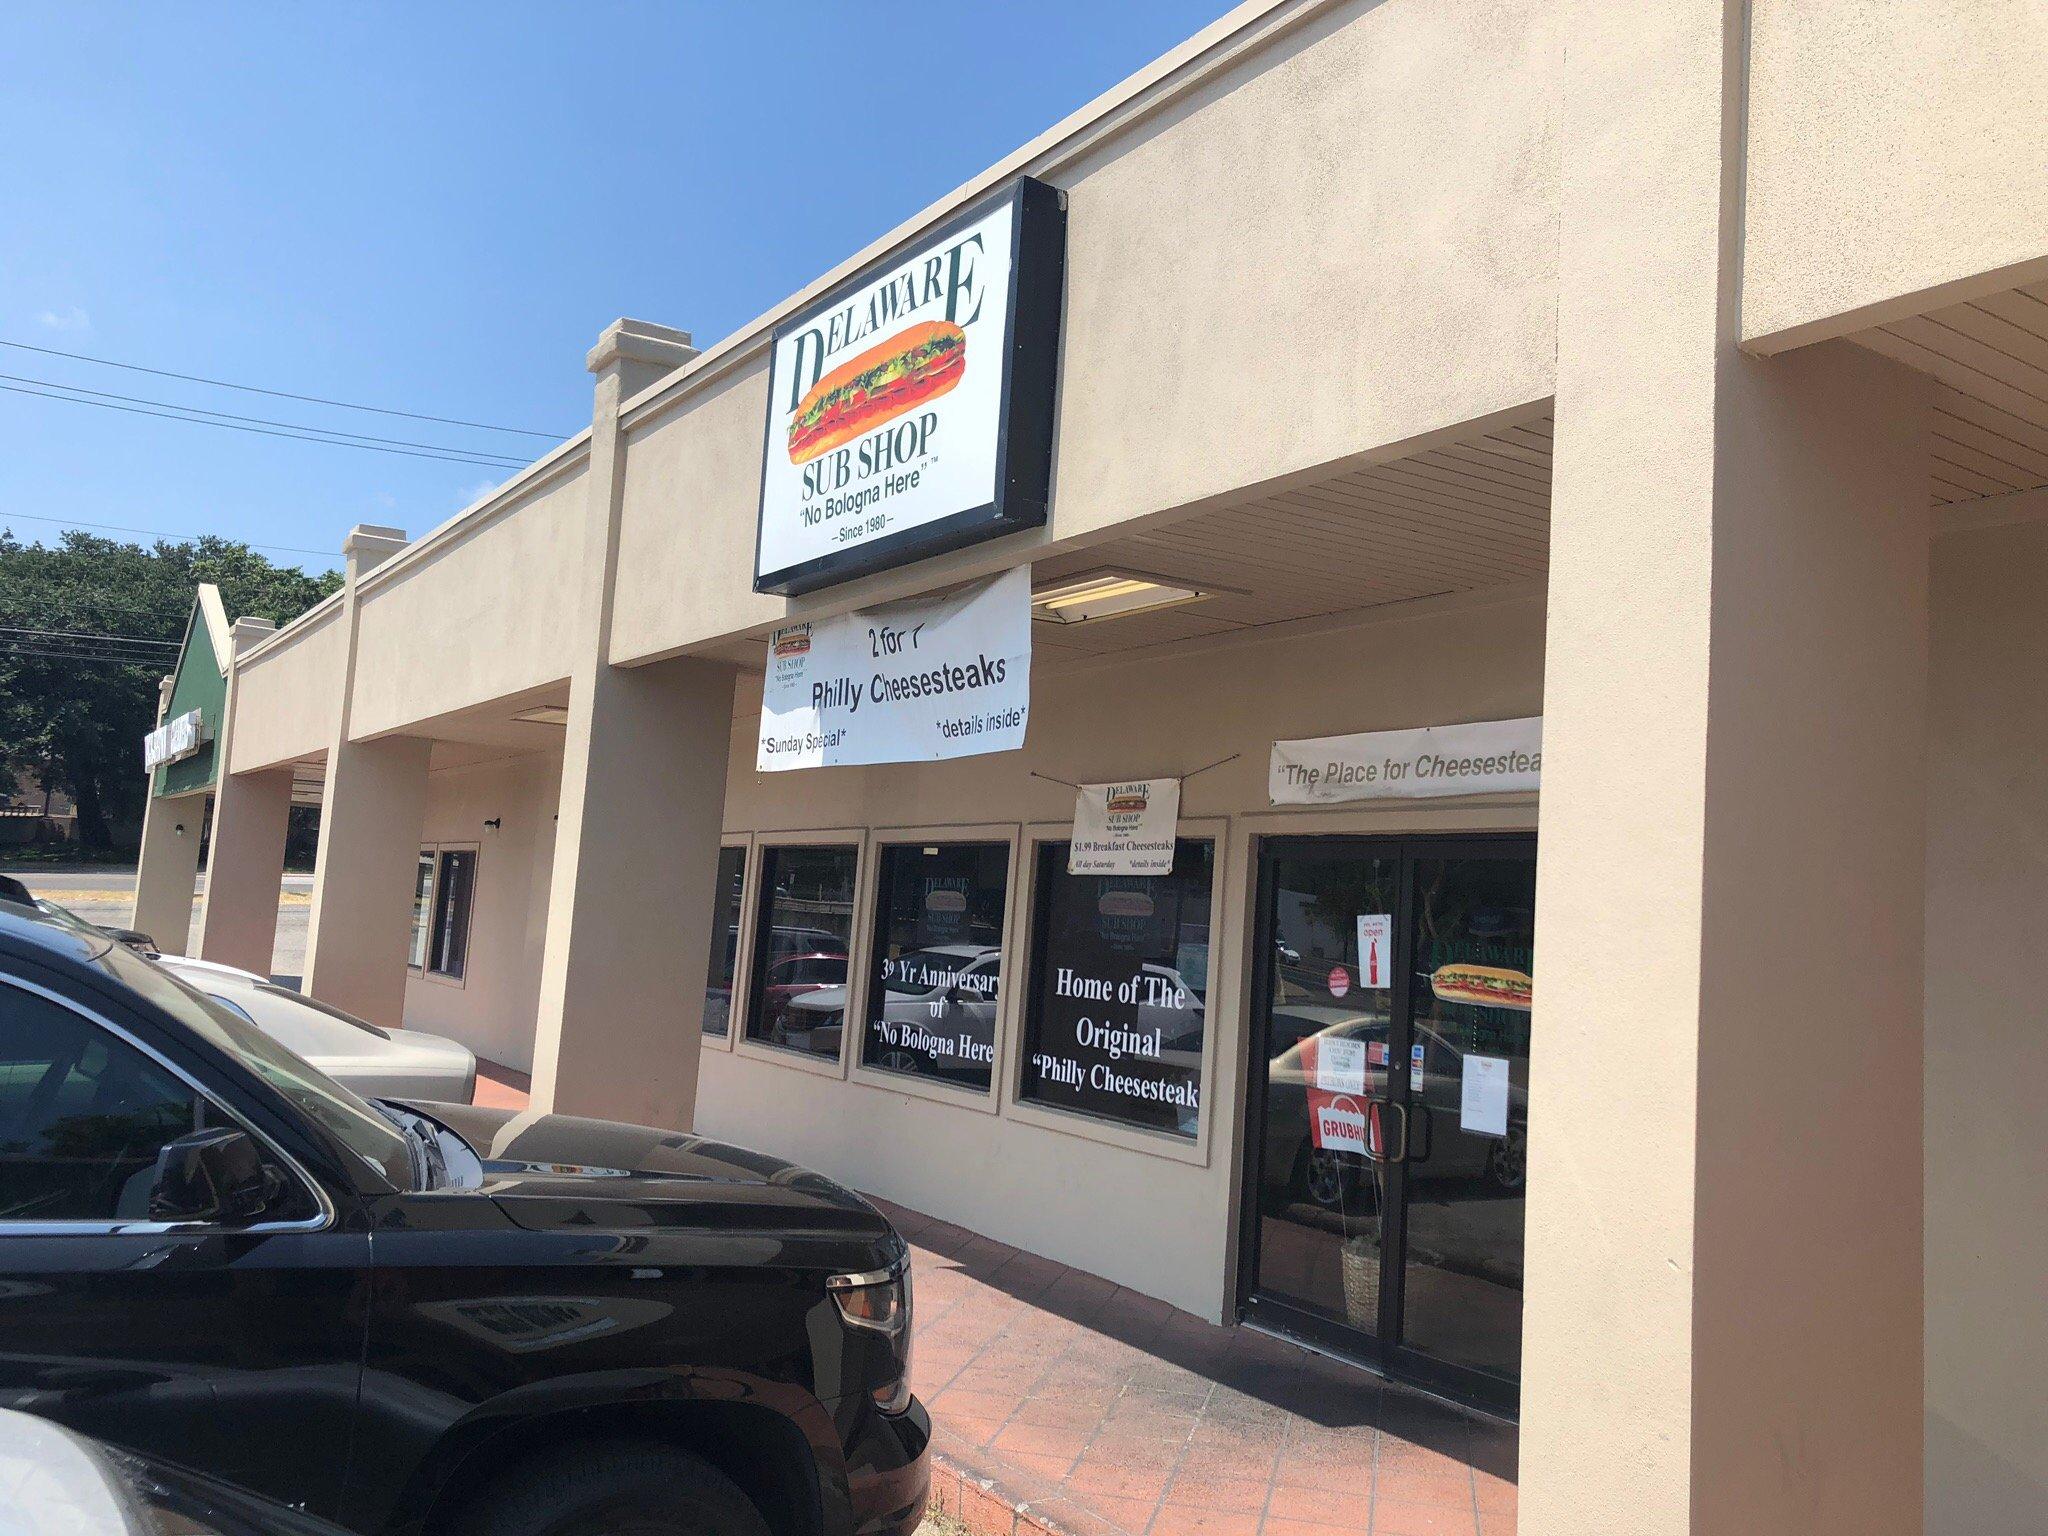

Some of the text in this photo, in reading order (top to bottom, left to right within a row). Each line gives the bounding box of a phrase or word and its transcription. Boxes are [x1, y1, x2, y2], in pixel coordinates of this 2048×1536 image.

[786, 232, 985, 415] DELAWARE
[802, 412, 938, 502] SUB SHOP
[825, 486, 880, 521] Bologna
[868, 628, 879, 658] 2
[880, 626, 906, 656] for
[812, 654, 1006, 713] Philly Cheesesteaks
[1325, 761, 1377, 785] Place
[1383, 758, 1410, 781] for
[1415, 750, 1541, 779] Cheesestea
[1093, 841, 1125, 852] Breakfast
[1126, 840, 1173, 851] Cheesesteaks
[880, 959, 895, 980] 39
[899, 960, 917, 985] Yr
[1055, 967, 1186, 1011] Home of The
[929, 996, 947, 1019] of
[901, 1024, 954, 1060] Bologna
[958, 1034, 994, 1064] Here
[1076, 1015, 1161, 1061] Original
[1090, 1064, 1199, 1109] Cheesesteak
